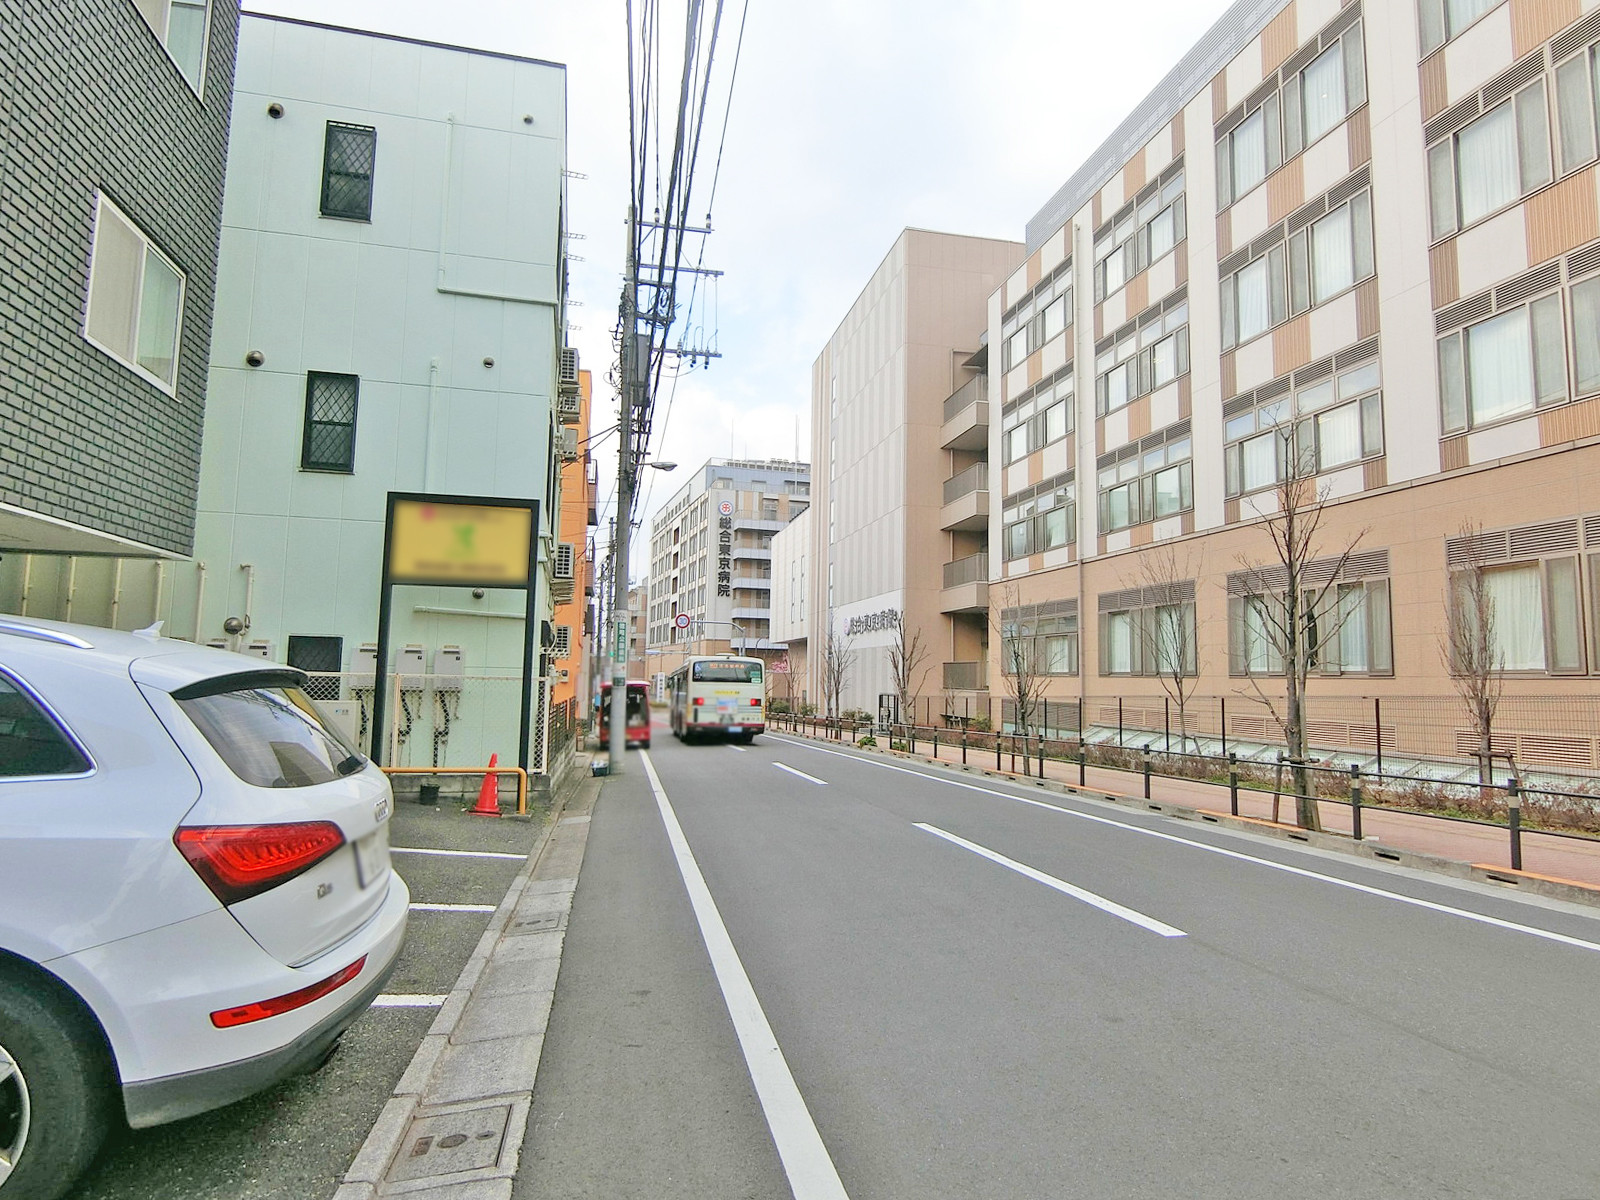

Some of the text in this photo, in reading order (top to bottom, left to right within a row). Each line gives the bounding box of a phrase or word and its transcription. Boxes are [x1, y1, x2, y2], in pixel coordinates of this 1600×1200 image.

[718, 516, 732, 597] 総合東京病院
[679, 617, 688, 625] 30
